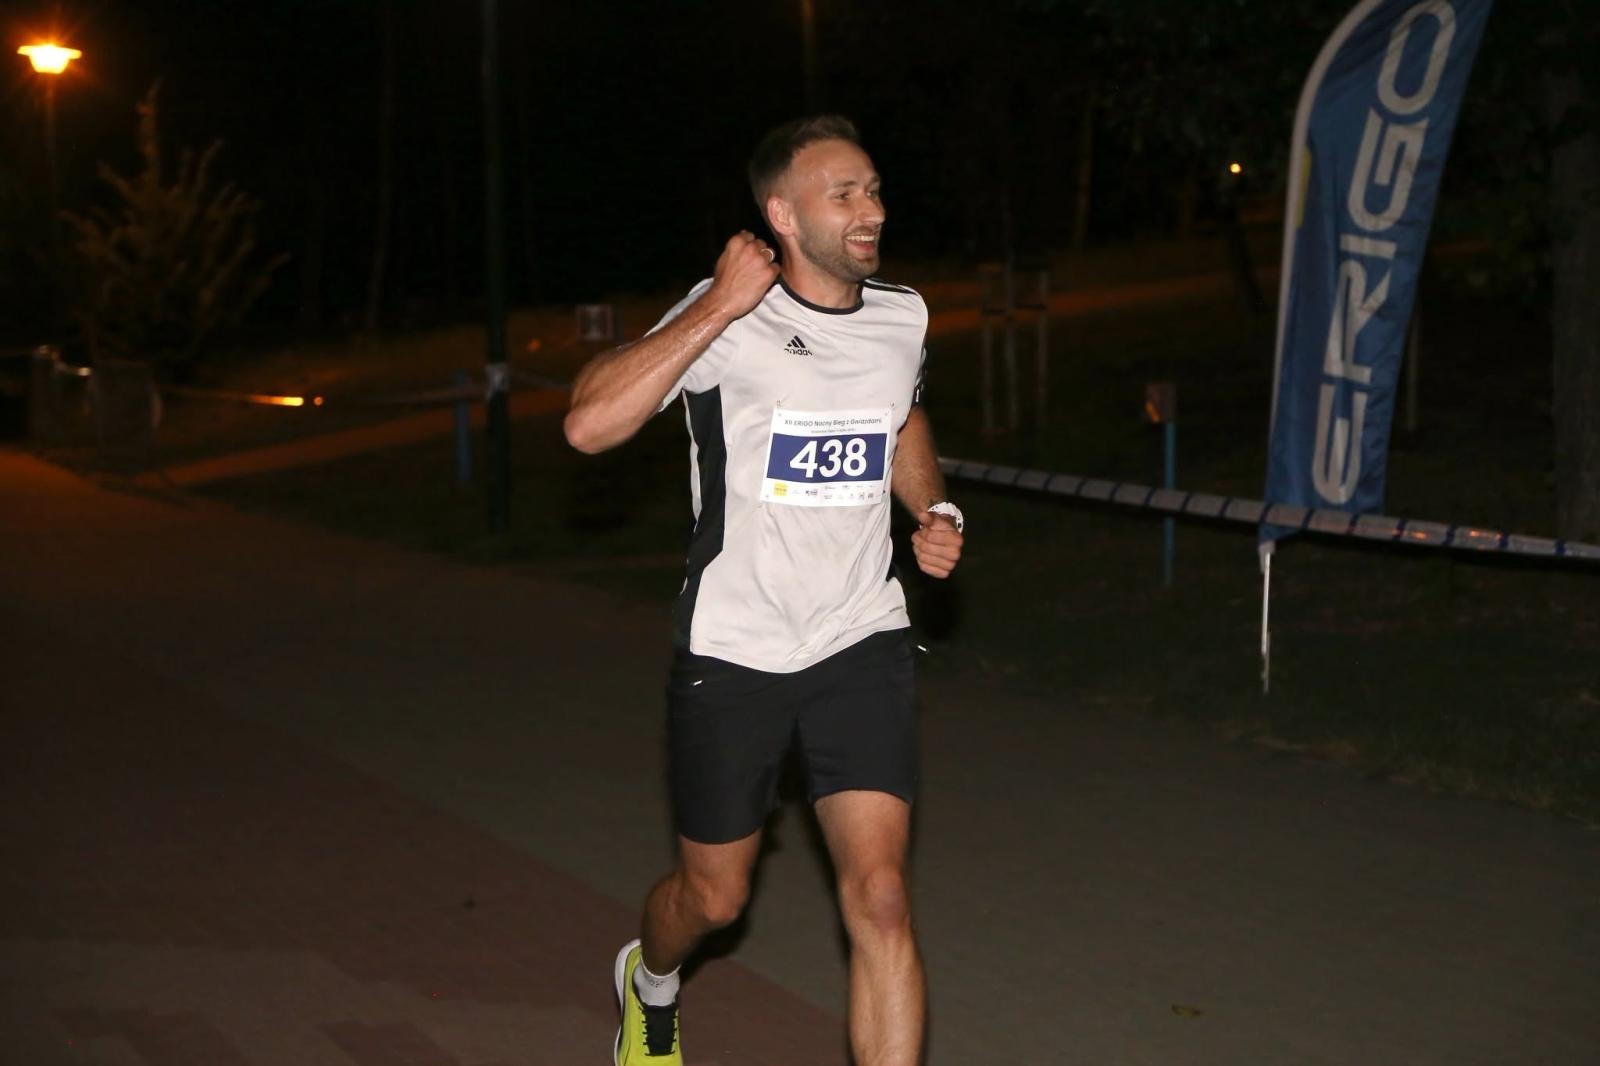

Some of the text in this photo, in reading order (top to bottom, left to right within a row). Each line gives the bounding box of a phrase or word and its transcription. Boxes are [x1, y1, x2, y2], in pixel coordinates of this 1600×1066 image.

[1311, 0, 1457, 504] ERIGO
[793, 419, 814, 427] ERIGO
[833, 419, 846, 427] Bieg
[789, 437, 867, 478] 438
